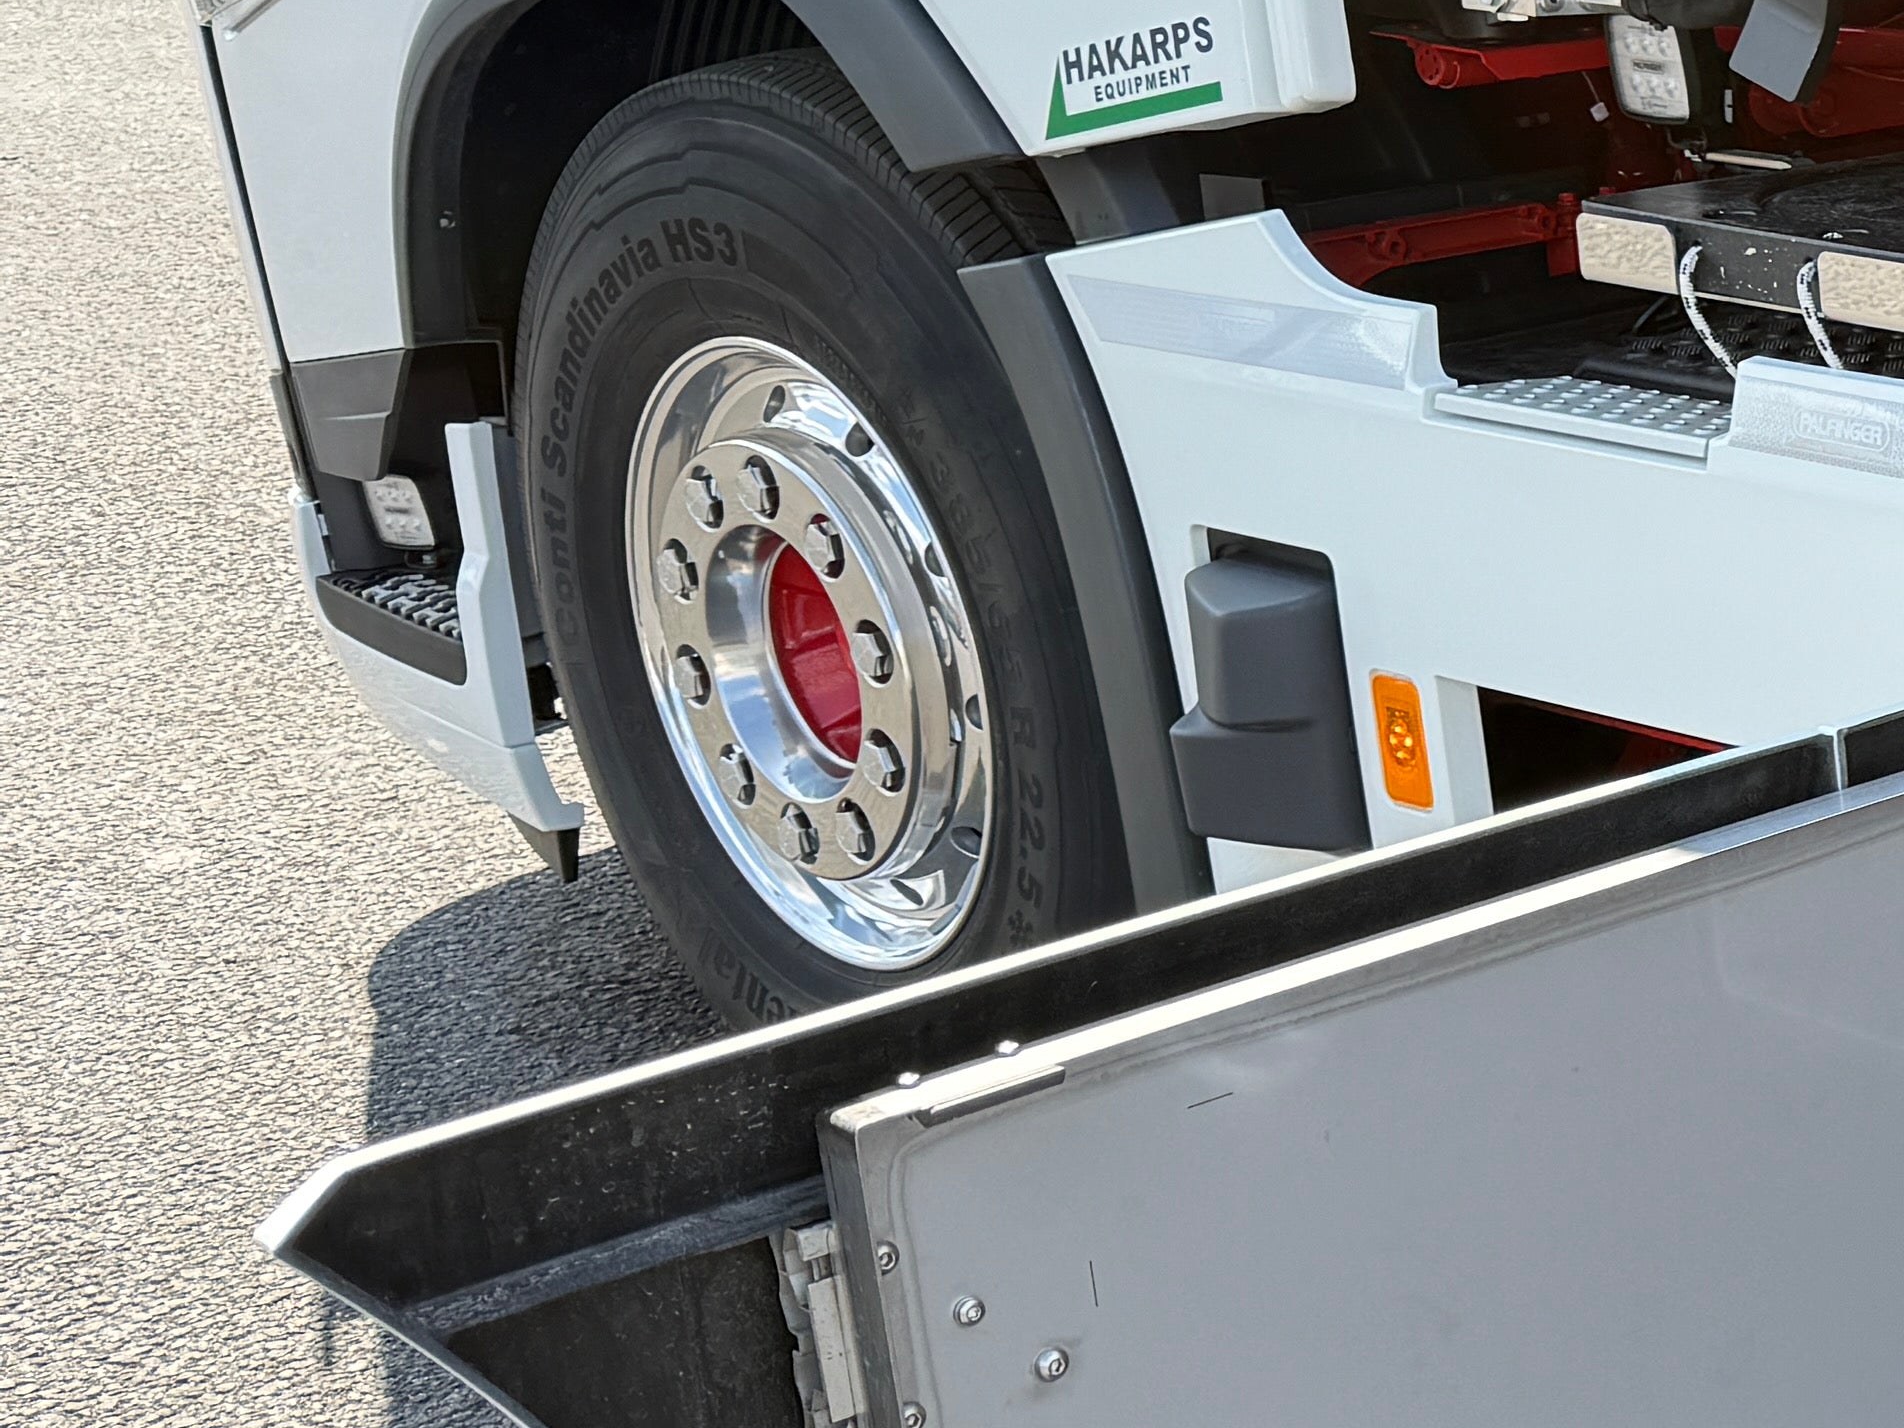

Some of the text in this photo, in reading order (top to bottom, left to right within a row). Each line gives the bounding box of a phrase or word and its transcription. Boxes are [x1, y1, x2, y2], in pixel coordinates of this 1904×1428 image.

[1063, 17, 1213, 85] HAKARPS
[1094, 65, 1190, 103] EQUIPMENT
[542, 235, 662, 473] Scandinavia
[660, 217, 739, 267] HS3
[1801, 411, 1883, 447] PALFINGER
